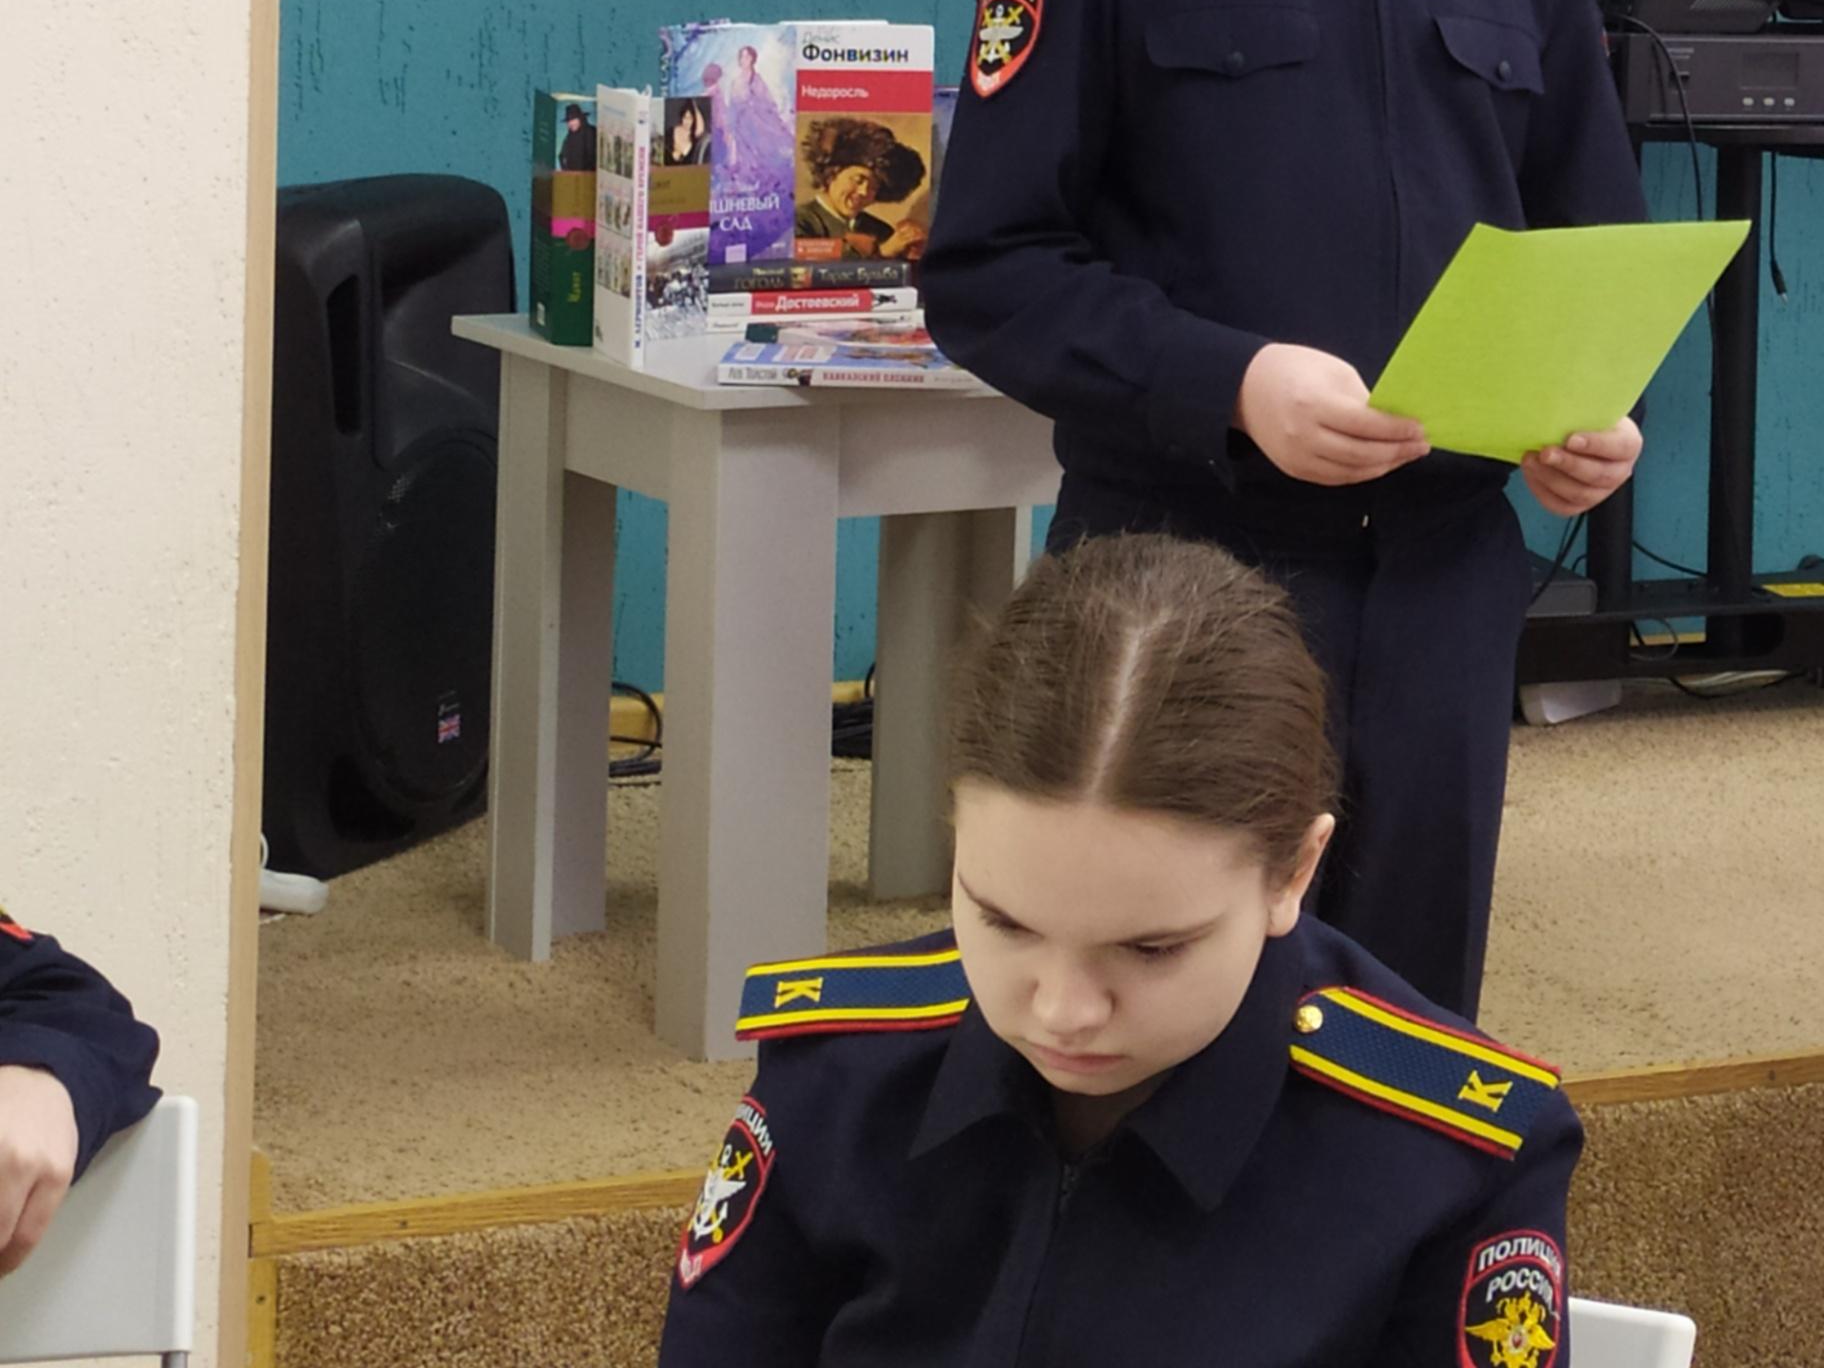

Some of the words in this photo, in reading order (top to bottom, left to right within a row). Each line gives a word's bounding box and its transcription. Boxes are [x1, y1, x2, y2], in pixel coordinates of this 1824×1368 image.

[801, 43, 909, 62] Фонвизин
[801, 85, 869, 99] Недоросль
[720, 216, 753, 232] САД
[775, 293, 860, 312] Достоевский
[775, 975, 823, 1008] К
[1458, 1069, 1514, 1113] К
